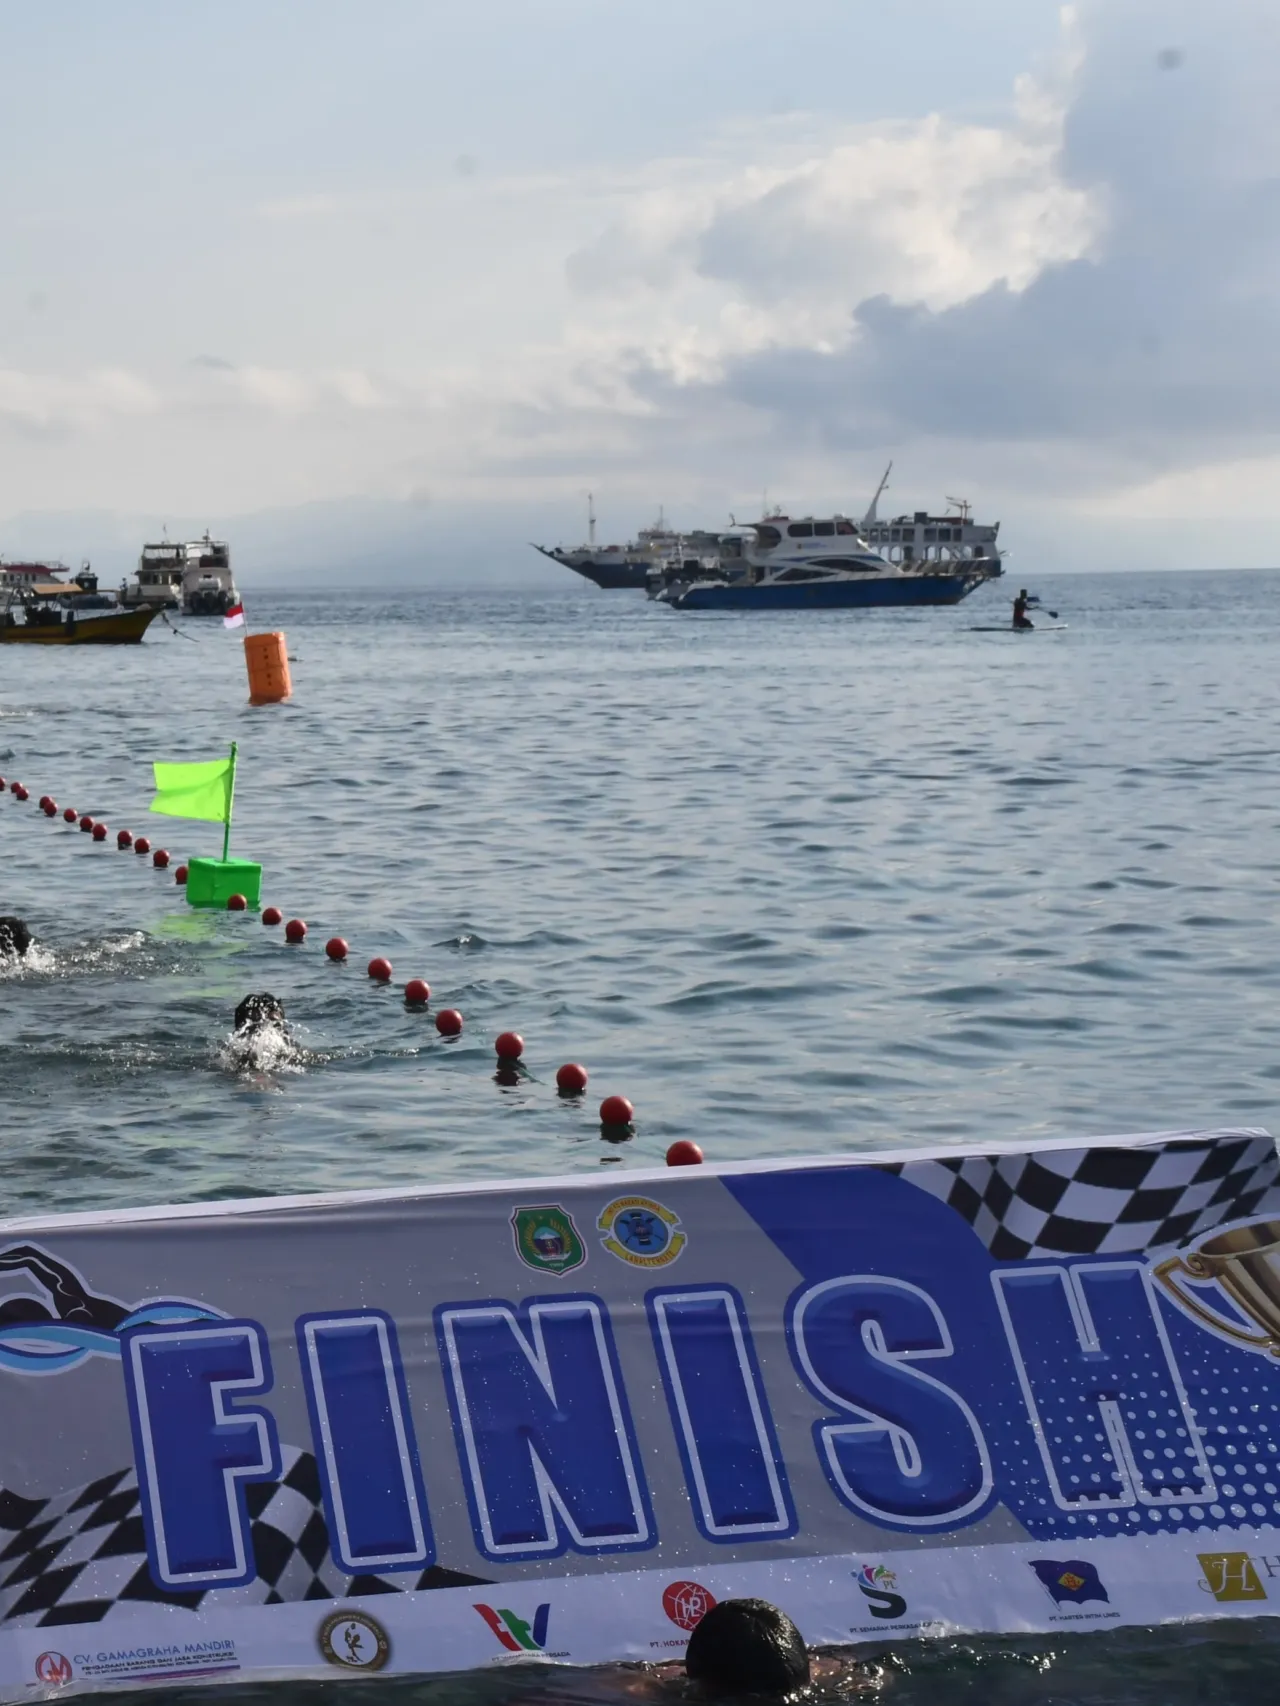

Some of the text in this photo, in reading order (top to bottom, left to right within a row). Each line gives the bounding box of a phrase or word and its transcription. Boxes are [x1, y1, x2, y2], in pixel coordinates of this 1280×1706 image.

[123, 1257, 1218, 1591] FINISH
[74, 1639, 236, 1665] CV. GAMAGRAHA MANDIRI
[649, 1641, 662, 1649] PT.
[157, 1657, 174, 1665] DAN
[174, 1655, 191, 1663] JASA
